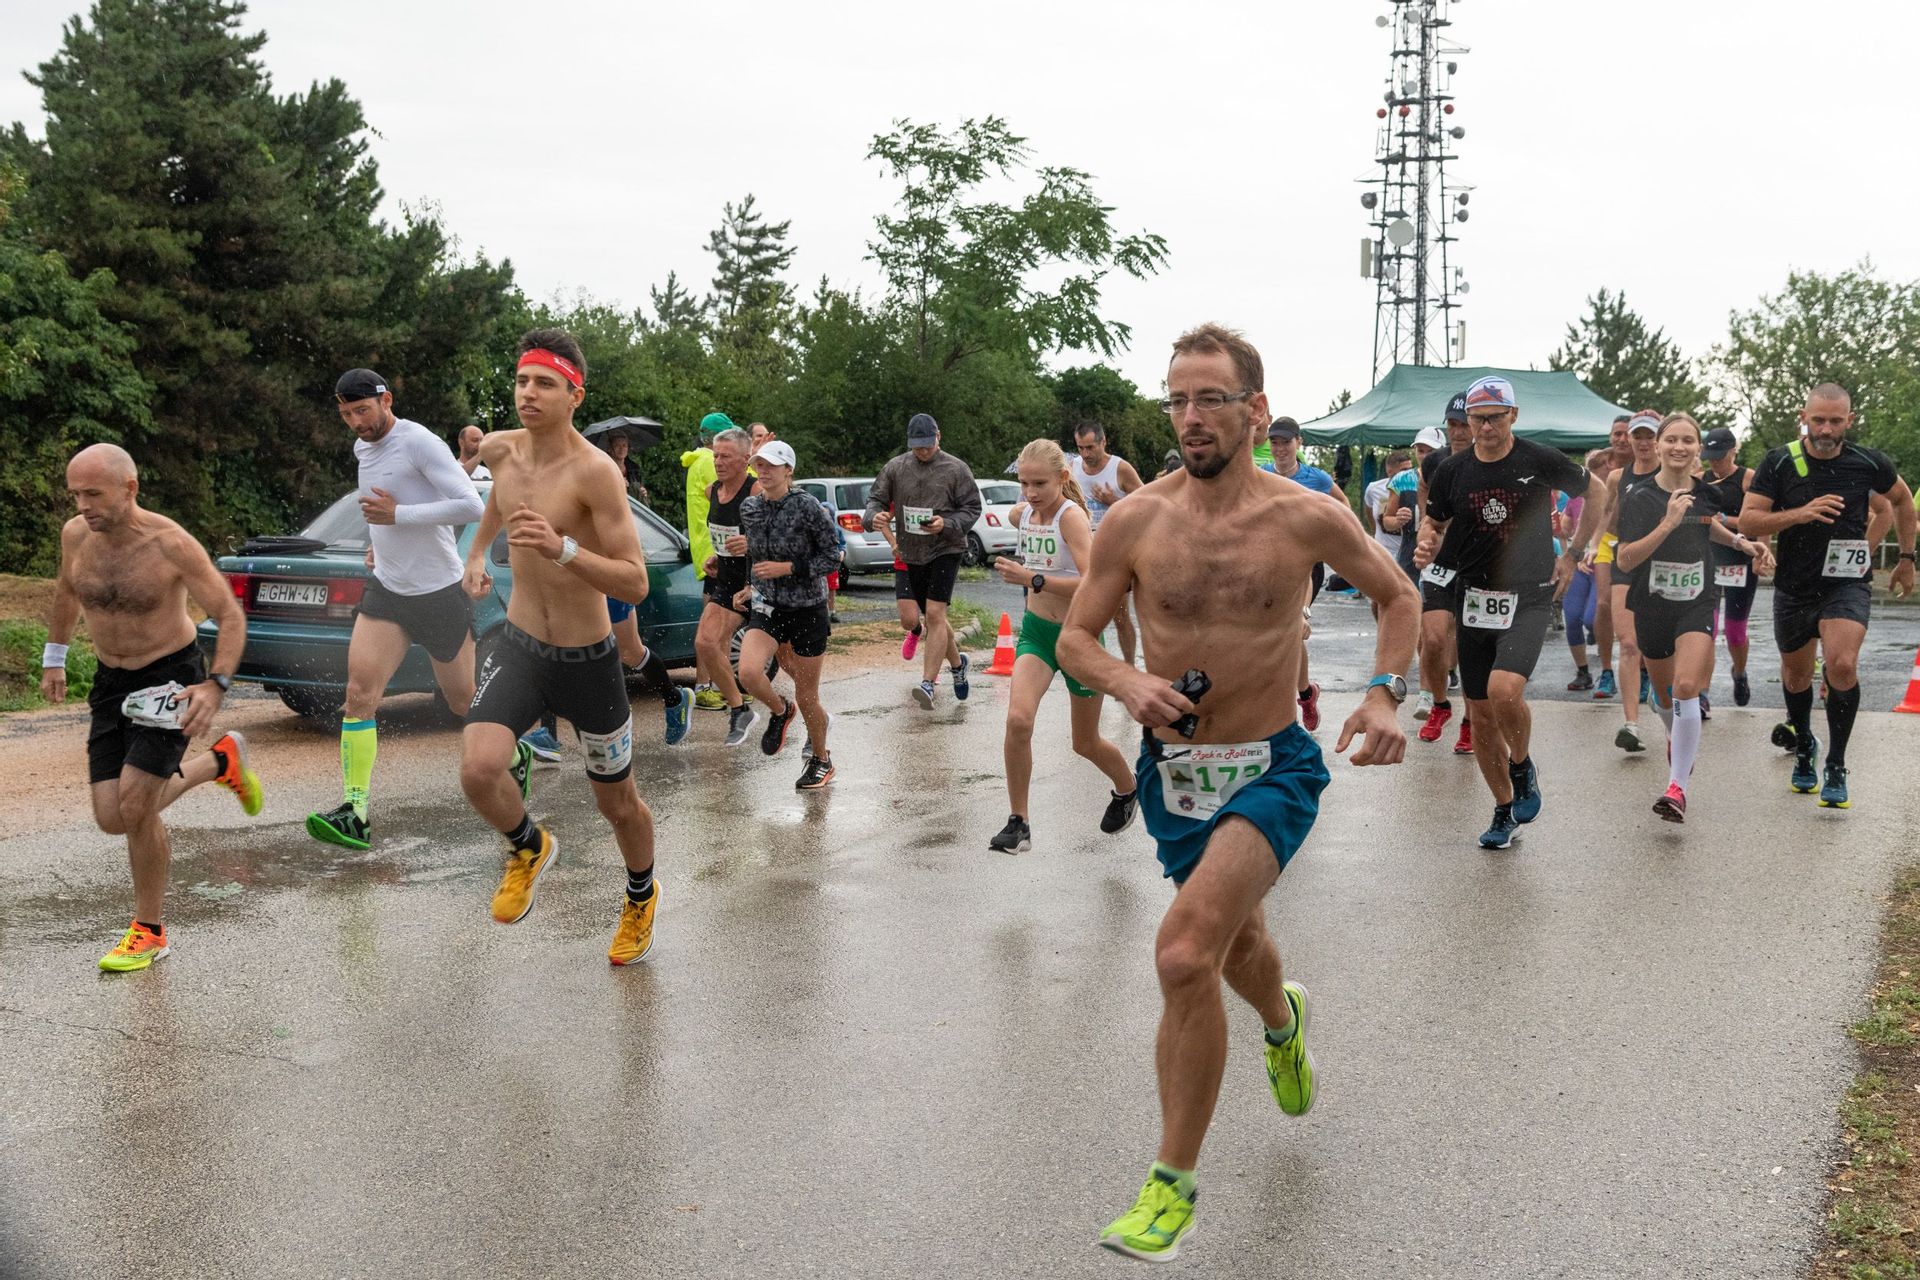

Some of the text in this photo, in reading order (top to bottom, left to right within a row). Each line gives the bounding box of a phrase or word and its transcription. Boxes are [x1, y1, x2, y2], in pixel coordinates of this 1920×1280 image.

[1482, 505, 1507, 515] ULTRA
[1027, 537, 1056, 555] 170
[1846, 549, 1867, 565] 78
[1670, 572, 1700, 587] 166
[1720, 566, 1744, 577] 154
[268, 585, 327, 603] GHW-419
[1485, 597, 1510, 615] 86
[607, 733, 630, 760] 15
